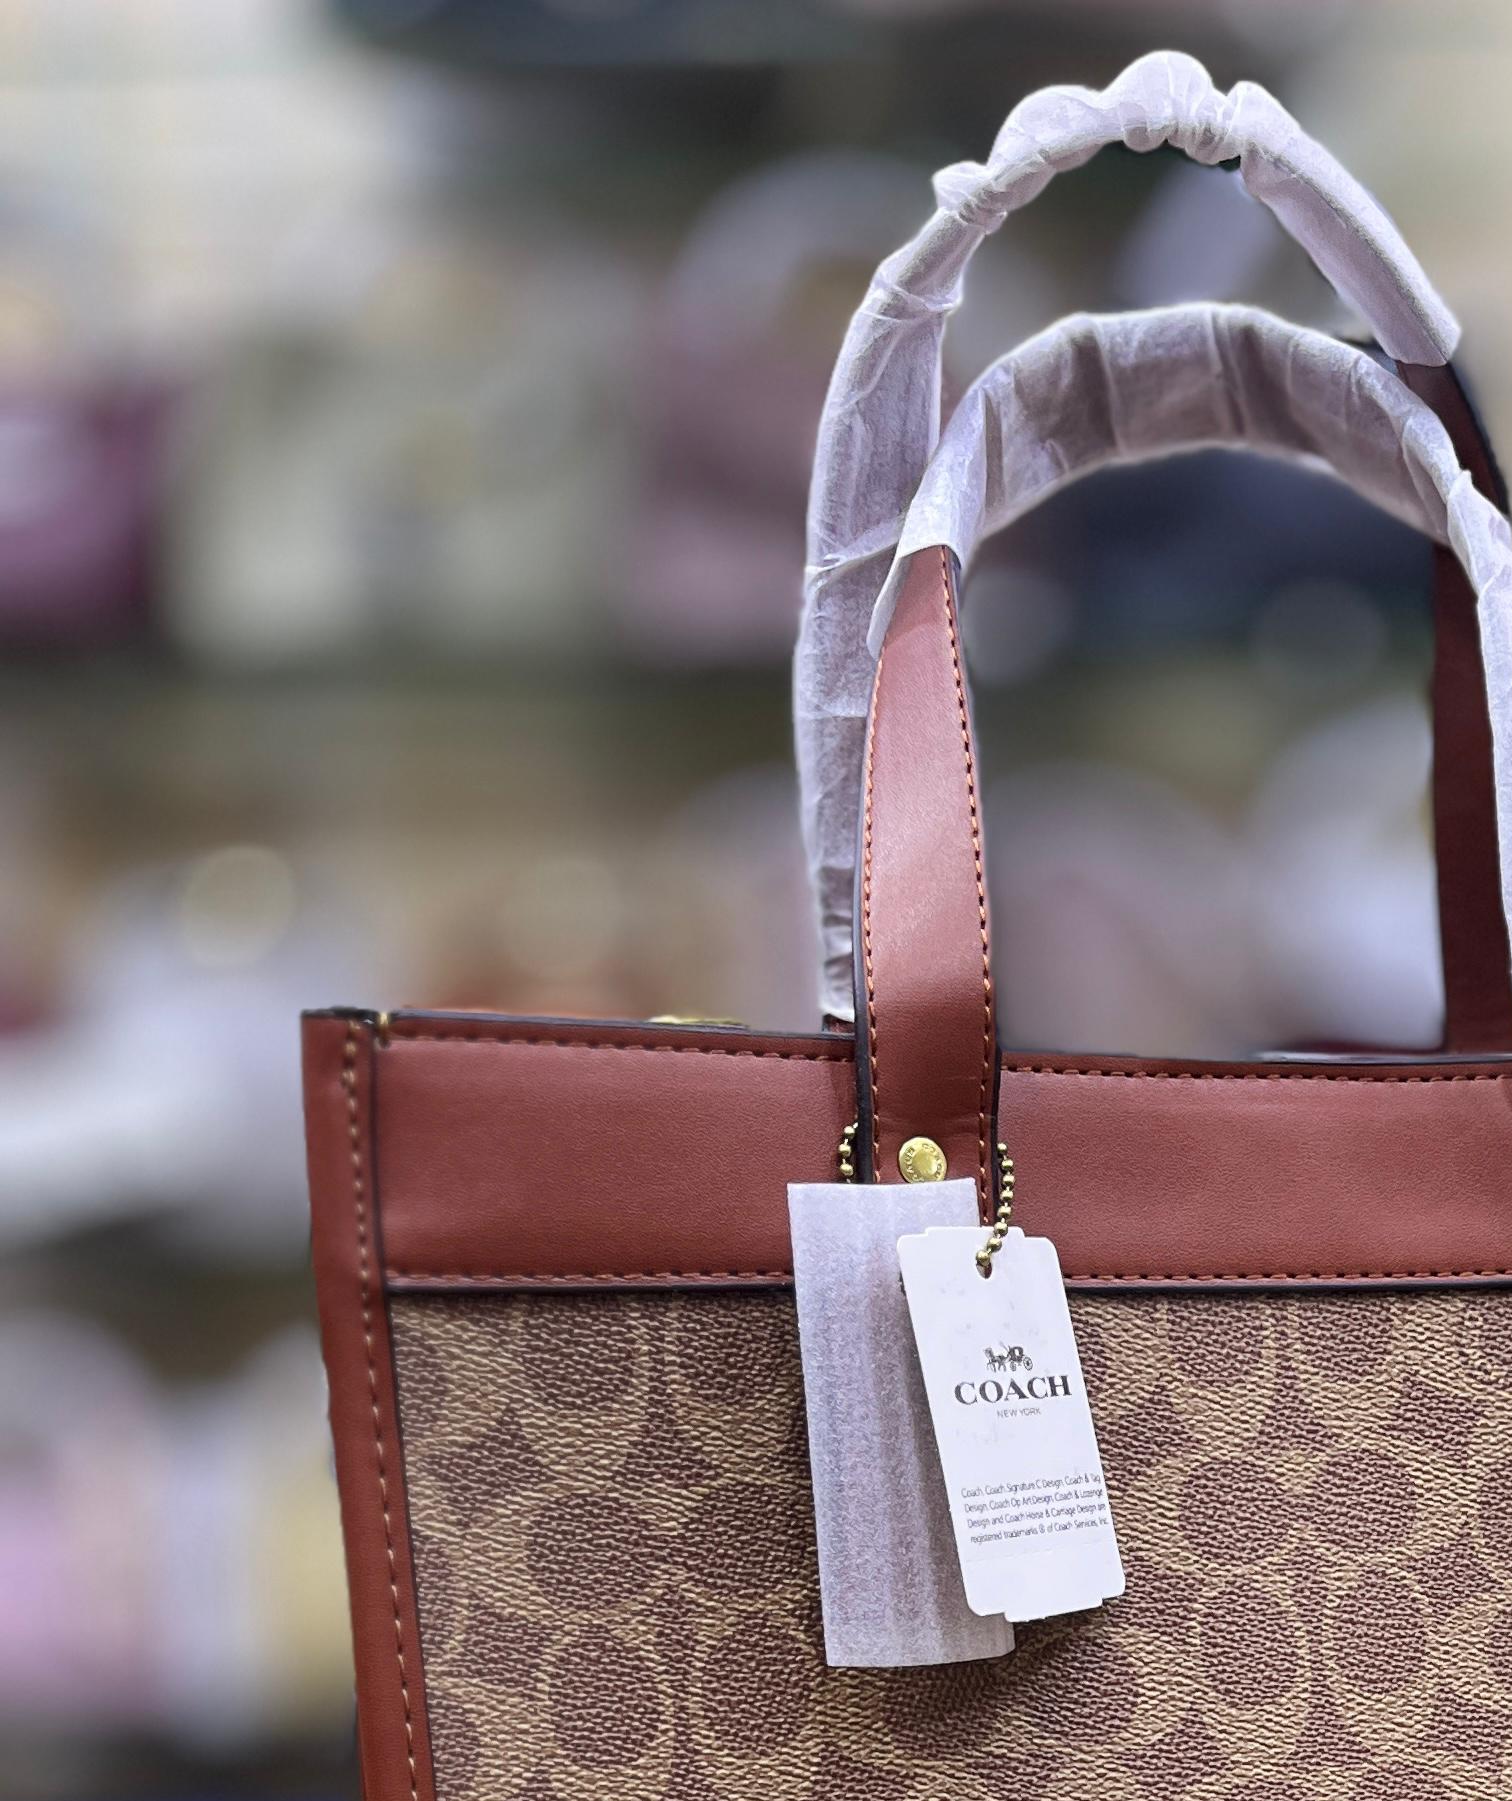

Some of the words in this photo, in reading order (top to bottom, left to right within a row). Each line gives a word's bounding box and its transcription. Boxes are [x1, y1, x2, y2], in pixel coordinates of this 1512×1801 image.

[954, 1375, 1072, 1405] COACH
[997, 1408, 1018, 1419] NEW
[1019, 1407, 1042, 1417] YORK
[967, 1517, 990, 1529] Design
[991, 1514, 1004, 1526] and
[1004, 1512, 1024, 1524] Coach
[1025, 1510, 1044, 1520] Horse
[1076, 1503, 1097, 1515] Design
[1054, 1520, 1073, 1532] Coach
